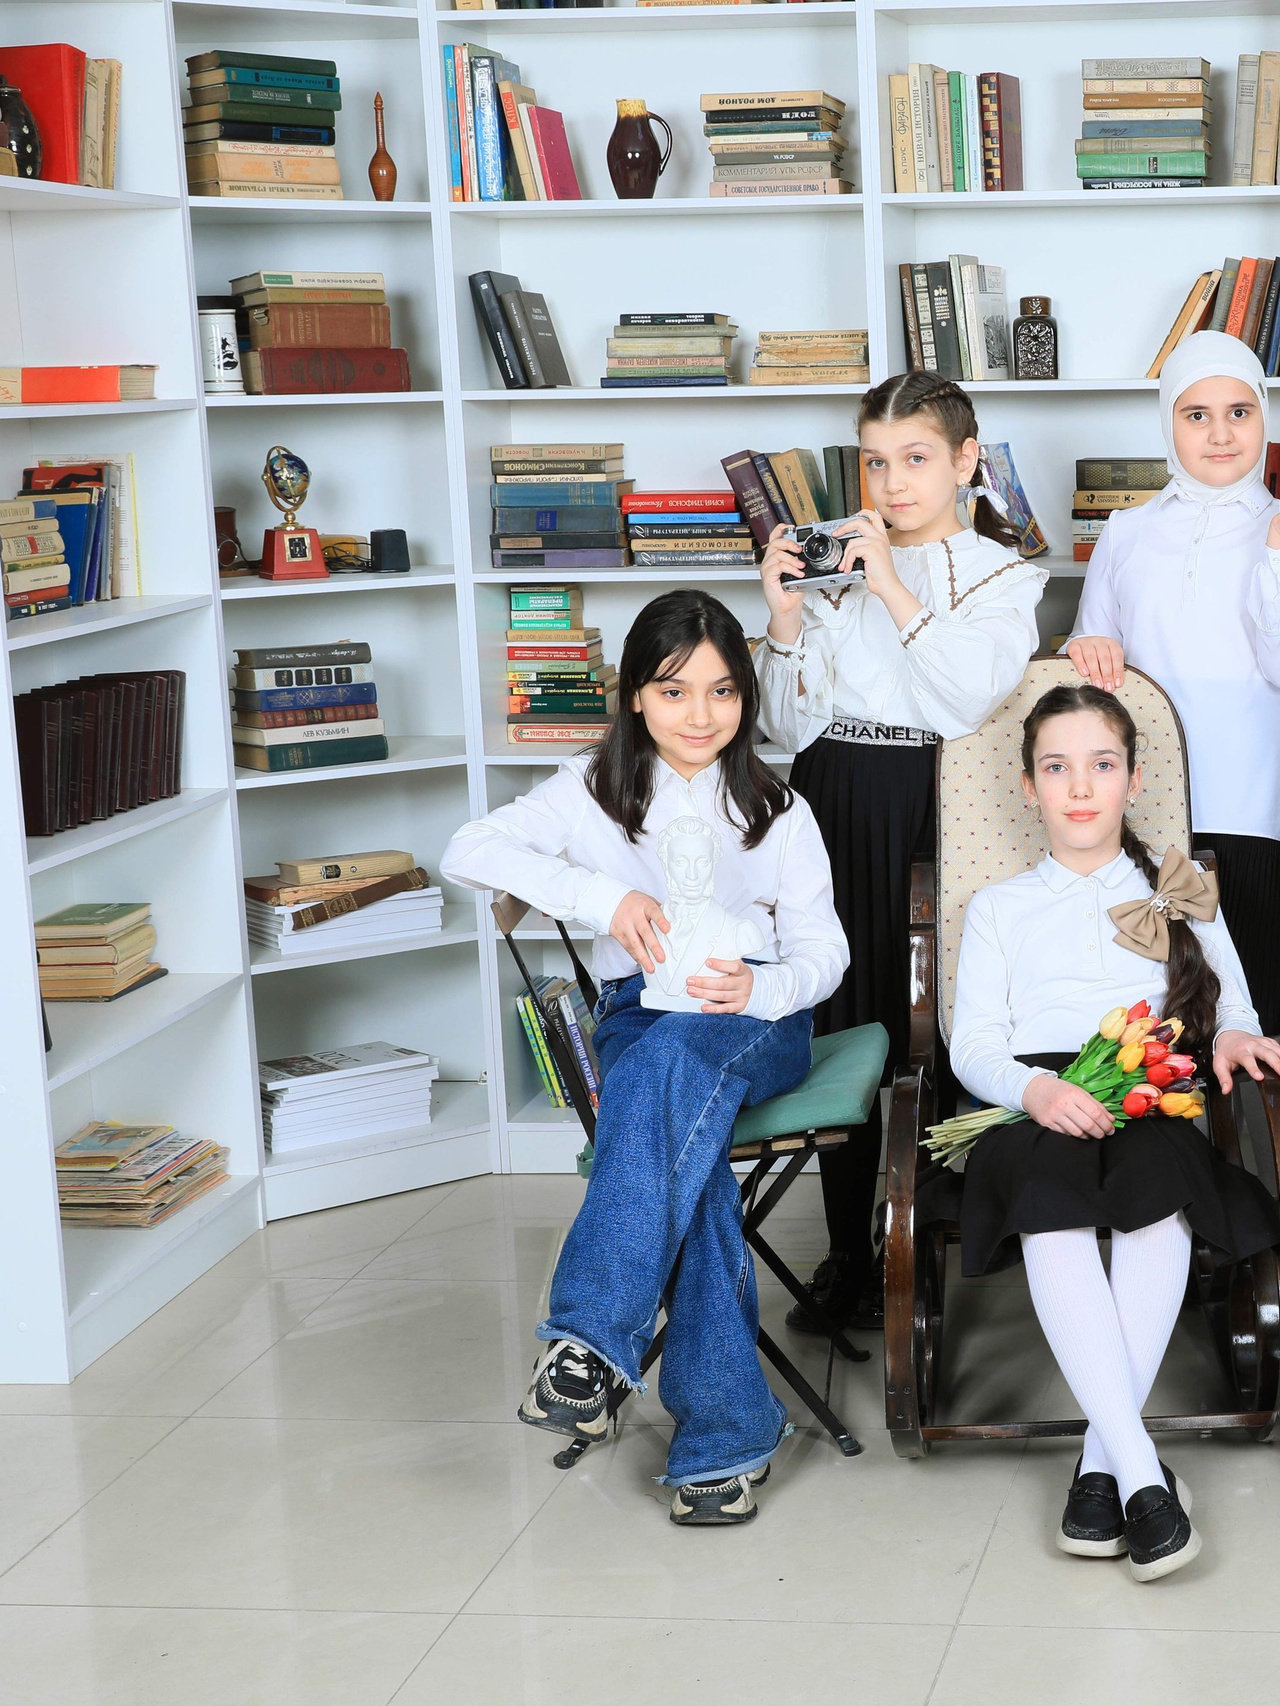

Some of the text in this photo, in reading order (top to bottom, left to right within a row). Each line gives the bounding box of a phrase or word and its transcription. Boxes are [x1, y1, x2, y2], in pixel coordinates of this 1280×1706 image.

[718, 97, 776, 106] ДОМ РОДНОЙ
[504, 96, 517, 123] КПСС
[895, 97, 910, 135] ФАРАОН
[913, 89, 925, 163] НОВАЯ ИСТОРИЯ
[483, 143, 495, 197] АНГЛИЙСКИЙ
[718, 166, 823, 176] КОММЕНТАРИЙ УПК РСФСР
[731, 185, 757, 194] СОВЕТСКОЕ
[758, 185, 802, 194] ГОСУДАРСТВЕННОЕ
[1258, 327, 1268, 354] ЛЮБОВЬ
[521, 337, 533, 361] ГАМЗАТОВ
[617, 358, 688, 366] ГИПЕРБОЛОИД ИНЖЕНЕРА ГАРИНА
[504, 463, 546, 472] СИМОНОВ
[668, 499, 724, 507] ЮРИЙ ТРИФОНОВ
[673, 541, 739, 549] АВТОМОБИЛИ
[302, 727, 350, 738] ЛЕВ КУЗЬМИН
[831, 722, 918, 741] CHANEL
[570, 1024, 597, 1089] ИСТОРИЯ РОССИИ
